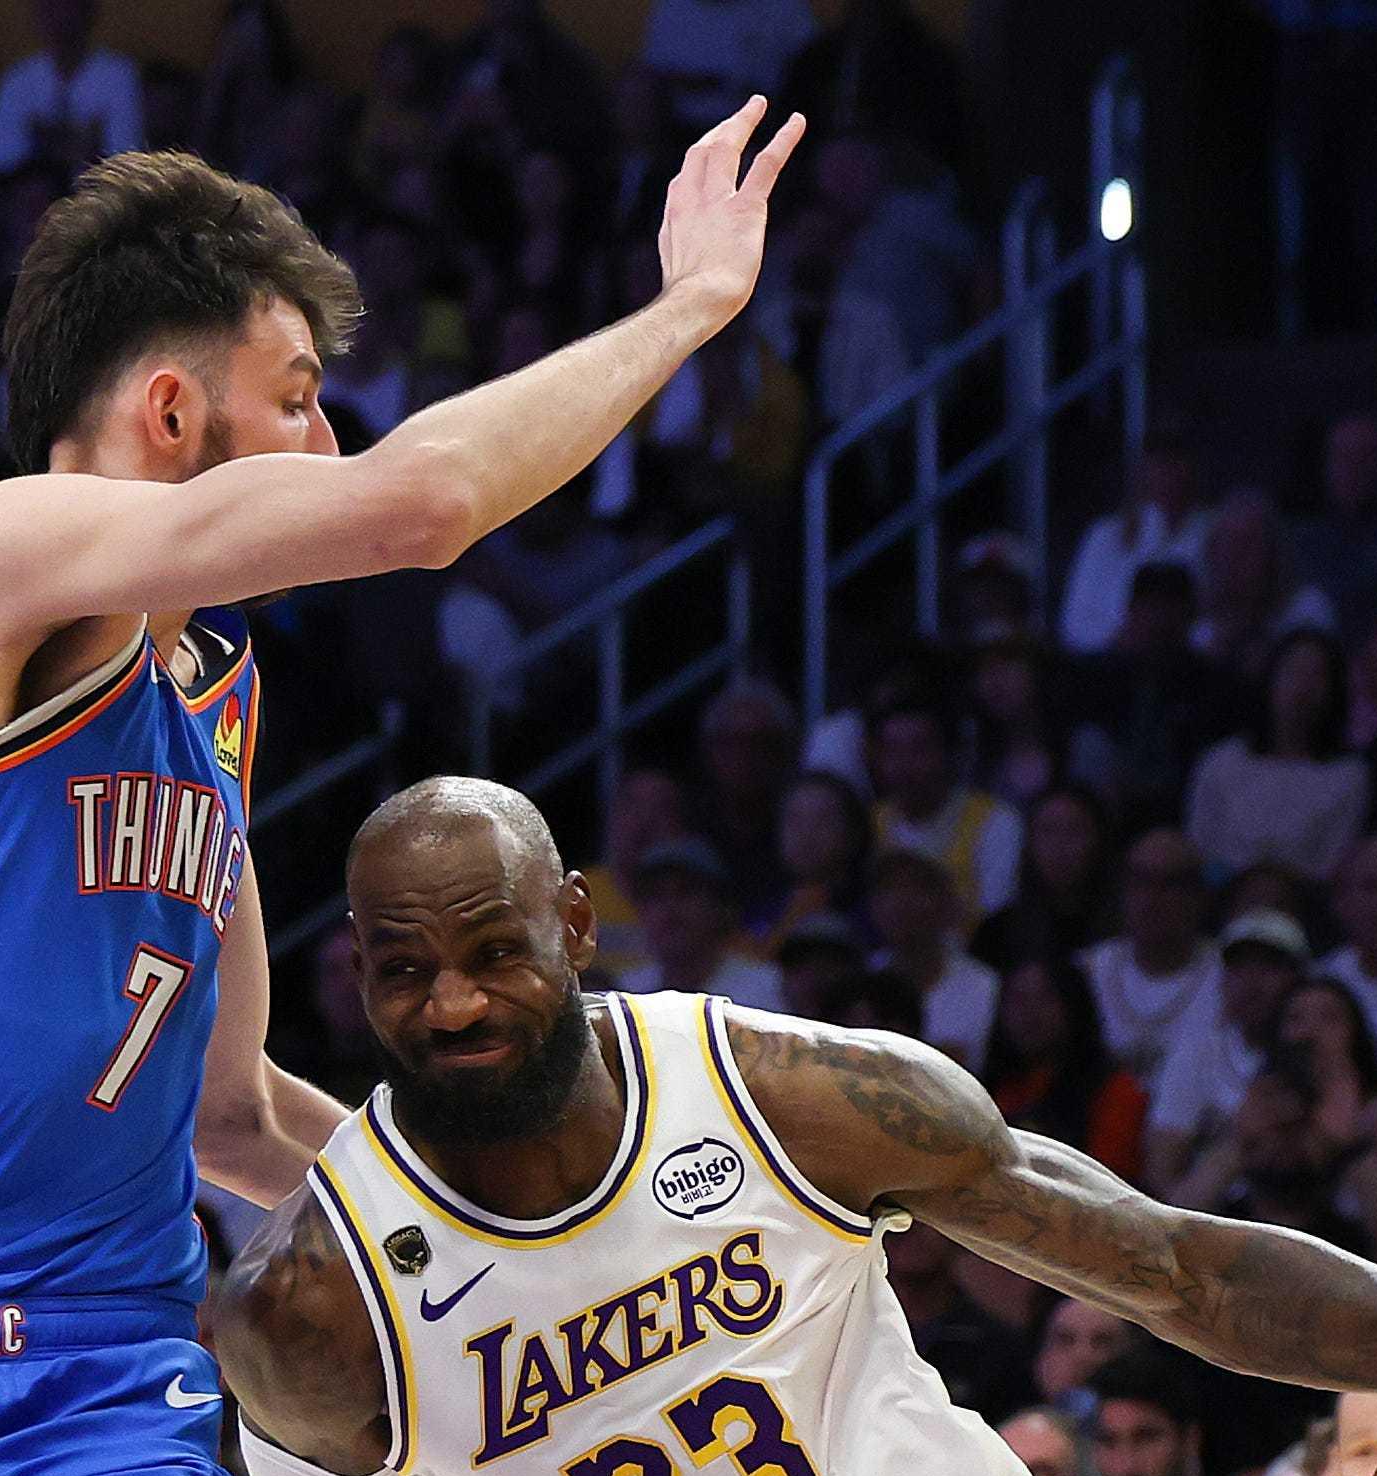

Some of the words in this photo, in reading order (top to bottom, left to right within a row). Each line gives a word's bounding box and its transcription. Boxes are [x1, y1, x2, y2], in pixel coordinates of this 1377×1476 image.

[67, 771, 244, 943] THUNDE
[86, 941, 195, 1113] 7
[658, 1156, 737, 1199] bibigo
[680, 1184, 714, 1204] 비비고
[463, 1230, 787, 1471] LAKERS
